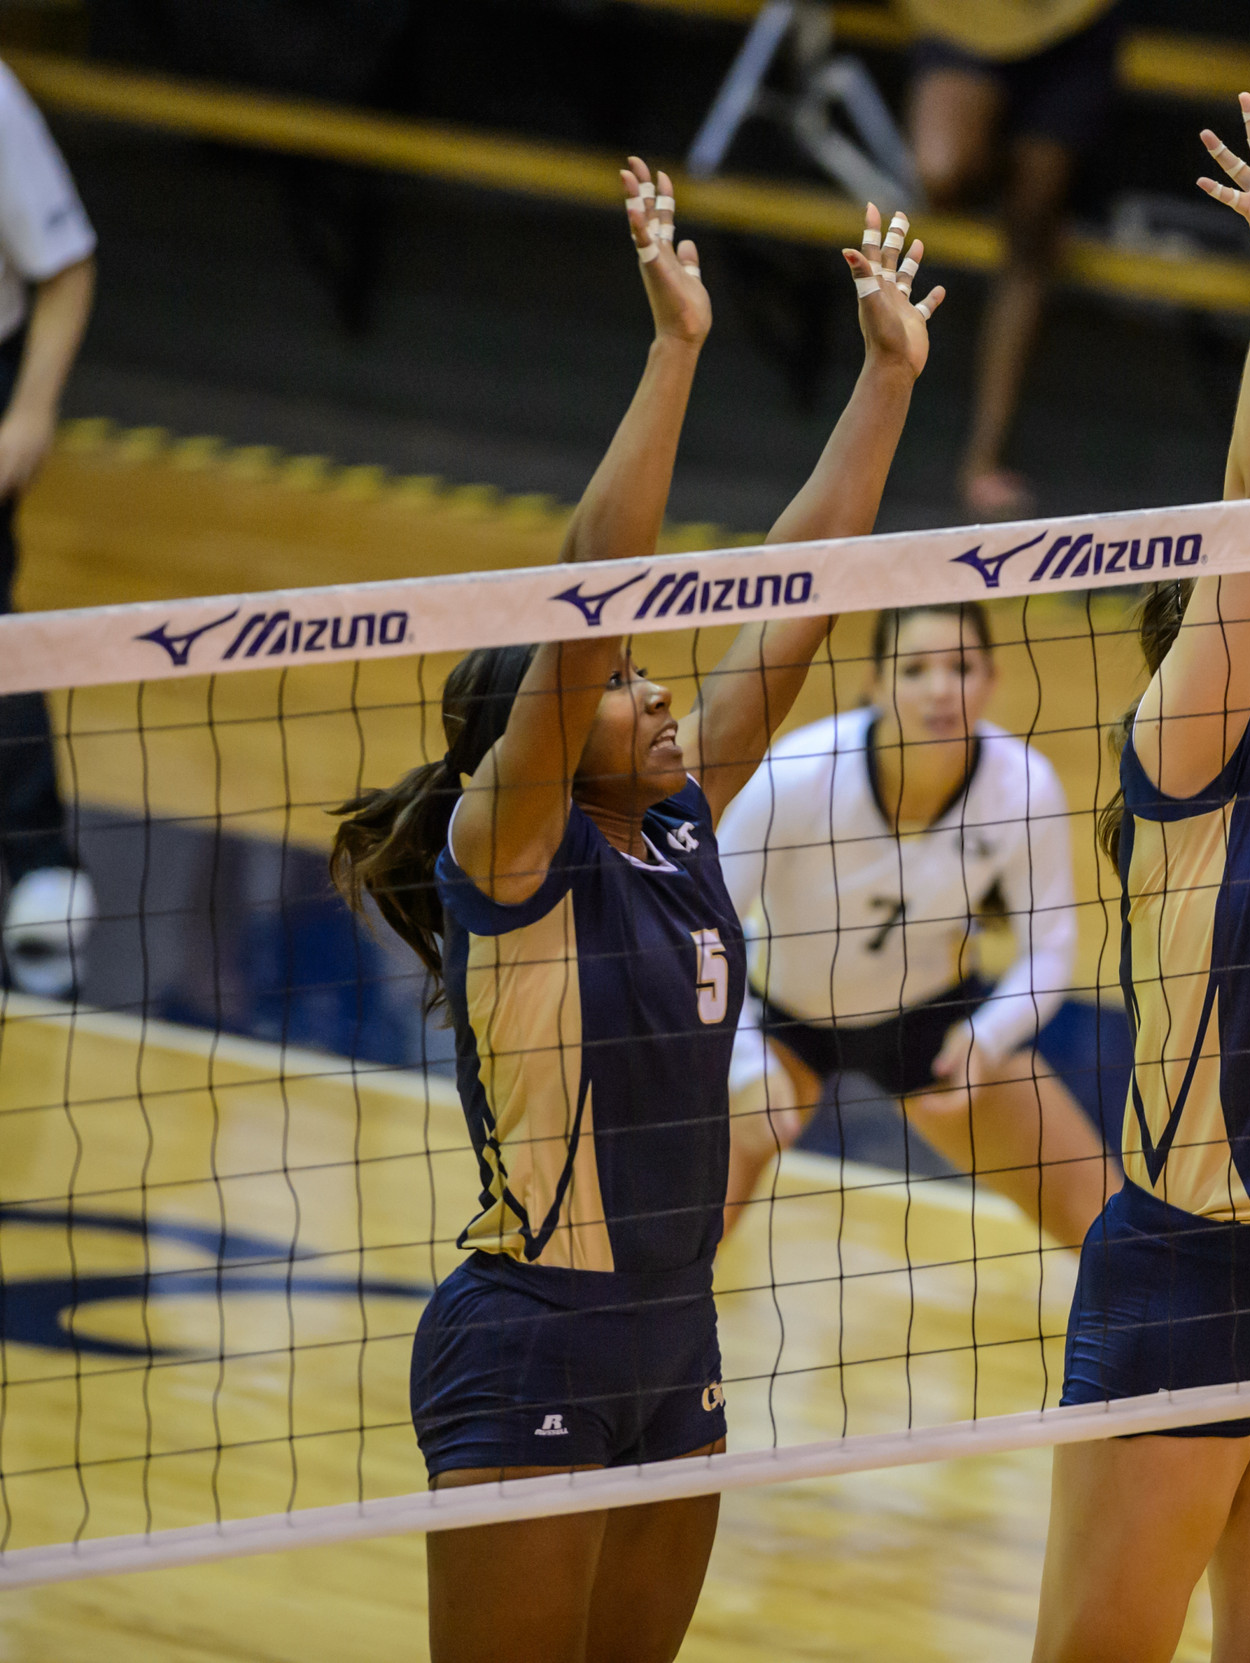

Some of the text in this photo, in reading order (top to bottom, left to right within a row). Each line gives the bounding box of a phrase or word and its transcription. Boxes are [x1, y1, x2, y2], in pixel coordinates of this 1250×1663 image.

[1030, 534, 1202, 581] MIZUNO
[634, 572, 812, 619] MIZUNO
[223, 612, 407, 659] MIZUNO
[866, 894, 911, 951] 7
[690, 927, 729, 1025] 5
